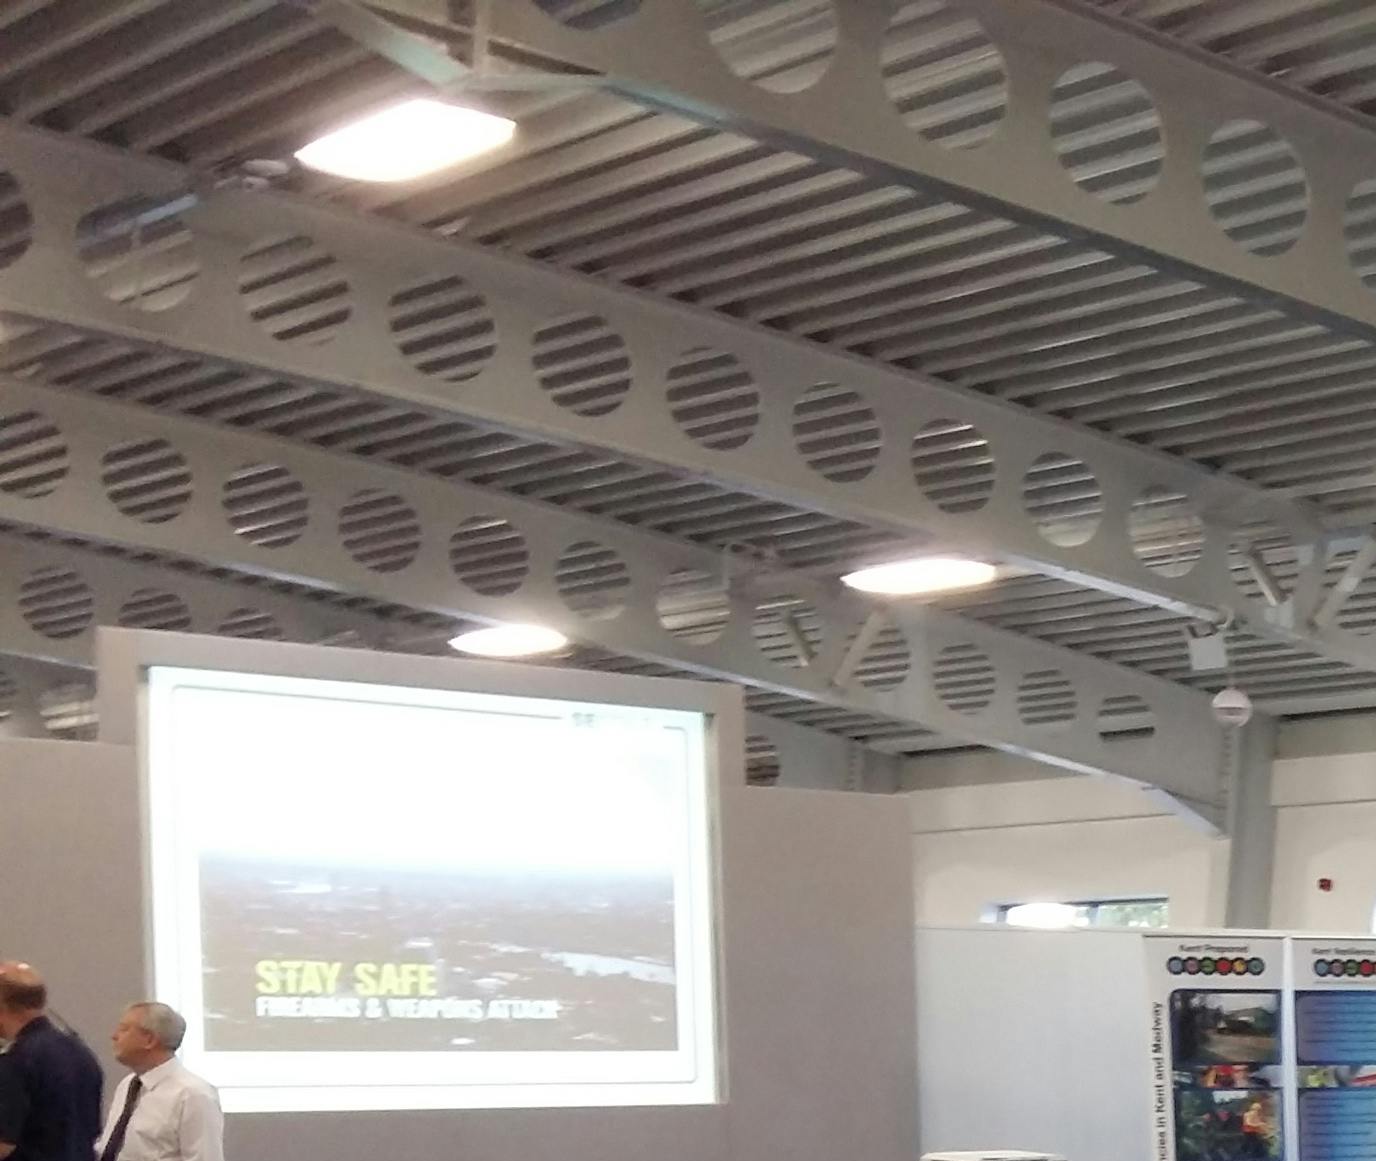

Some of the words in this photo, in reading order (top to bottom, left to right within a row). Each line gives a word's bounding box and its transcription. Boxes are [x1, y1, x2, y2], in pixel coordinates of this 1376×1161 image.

[255, 960, 341, 995] STAY
[354, 962, 438, 997] SAFE
[1151, 1002, 1163, 1054] Medway
[1153, 1057, 1164, 1080] and
[1155, 1084, 1166, 1113] Kent
[1155, 1117, 1165, 1128] in
